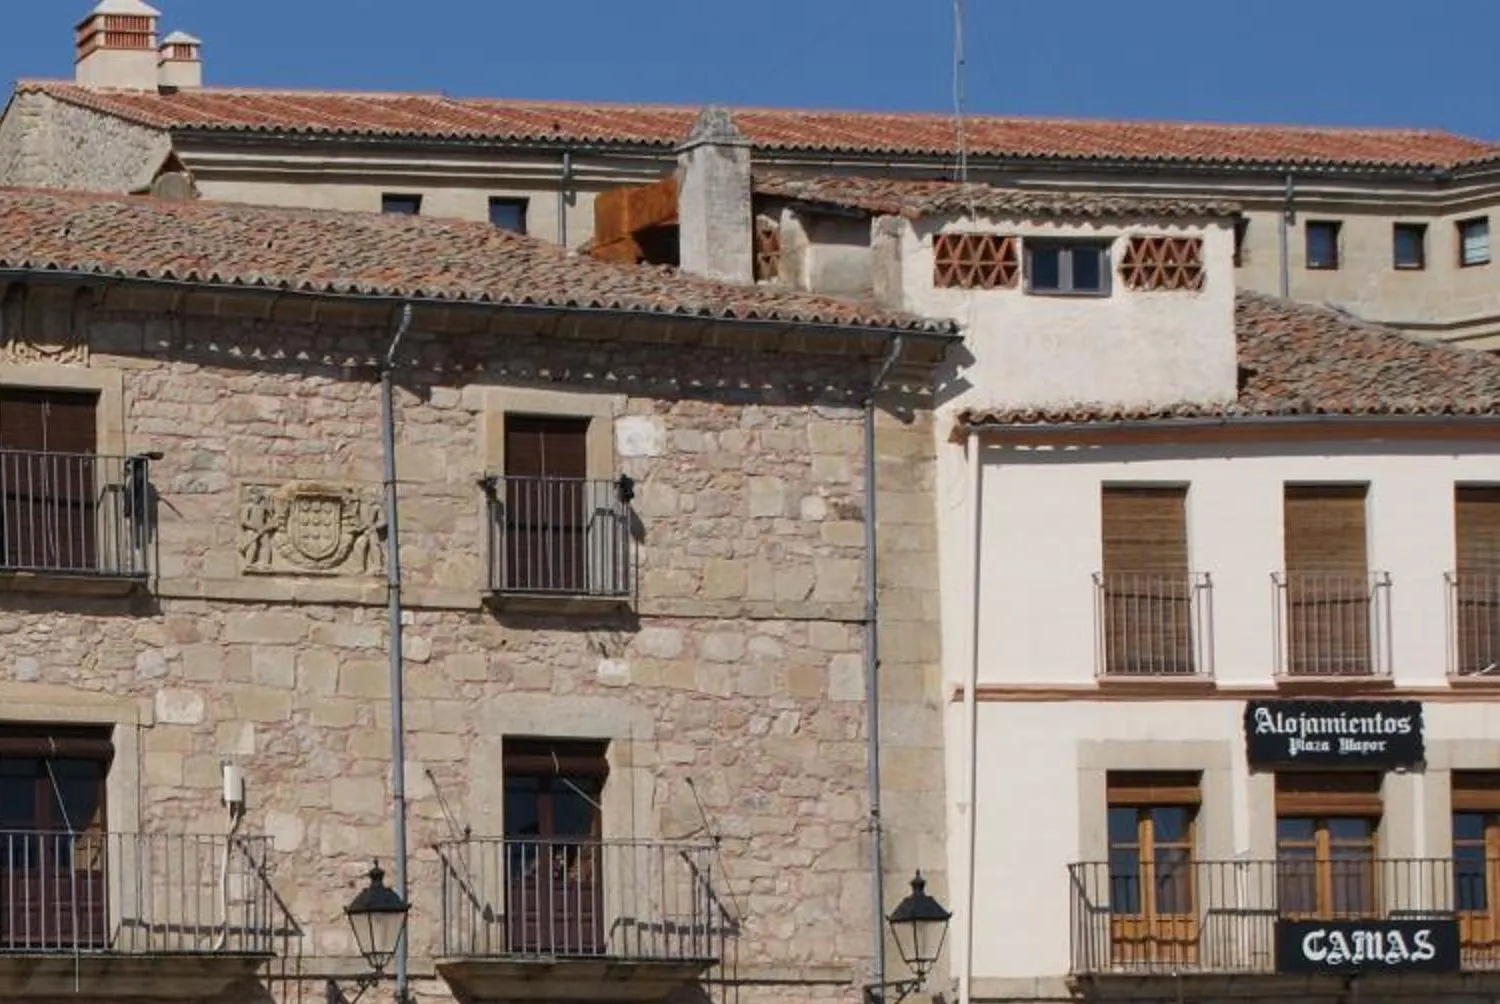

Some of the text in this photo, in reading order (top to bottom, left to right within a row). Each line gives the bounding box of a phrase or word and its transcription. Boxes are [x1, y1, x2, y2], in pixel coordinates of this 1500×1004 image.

[1254, 707, 1412, 738] Alojamientos
[1288, 737, 1388, 756] Plaza Mayor
[1302, 929, 1436, 965] CAMAS
